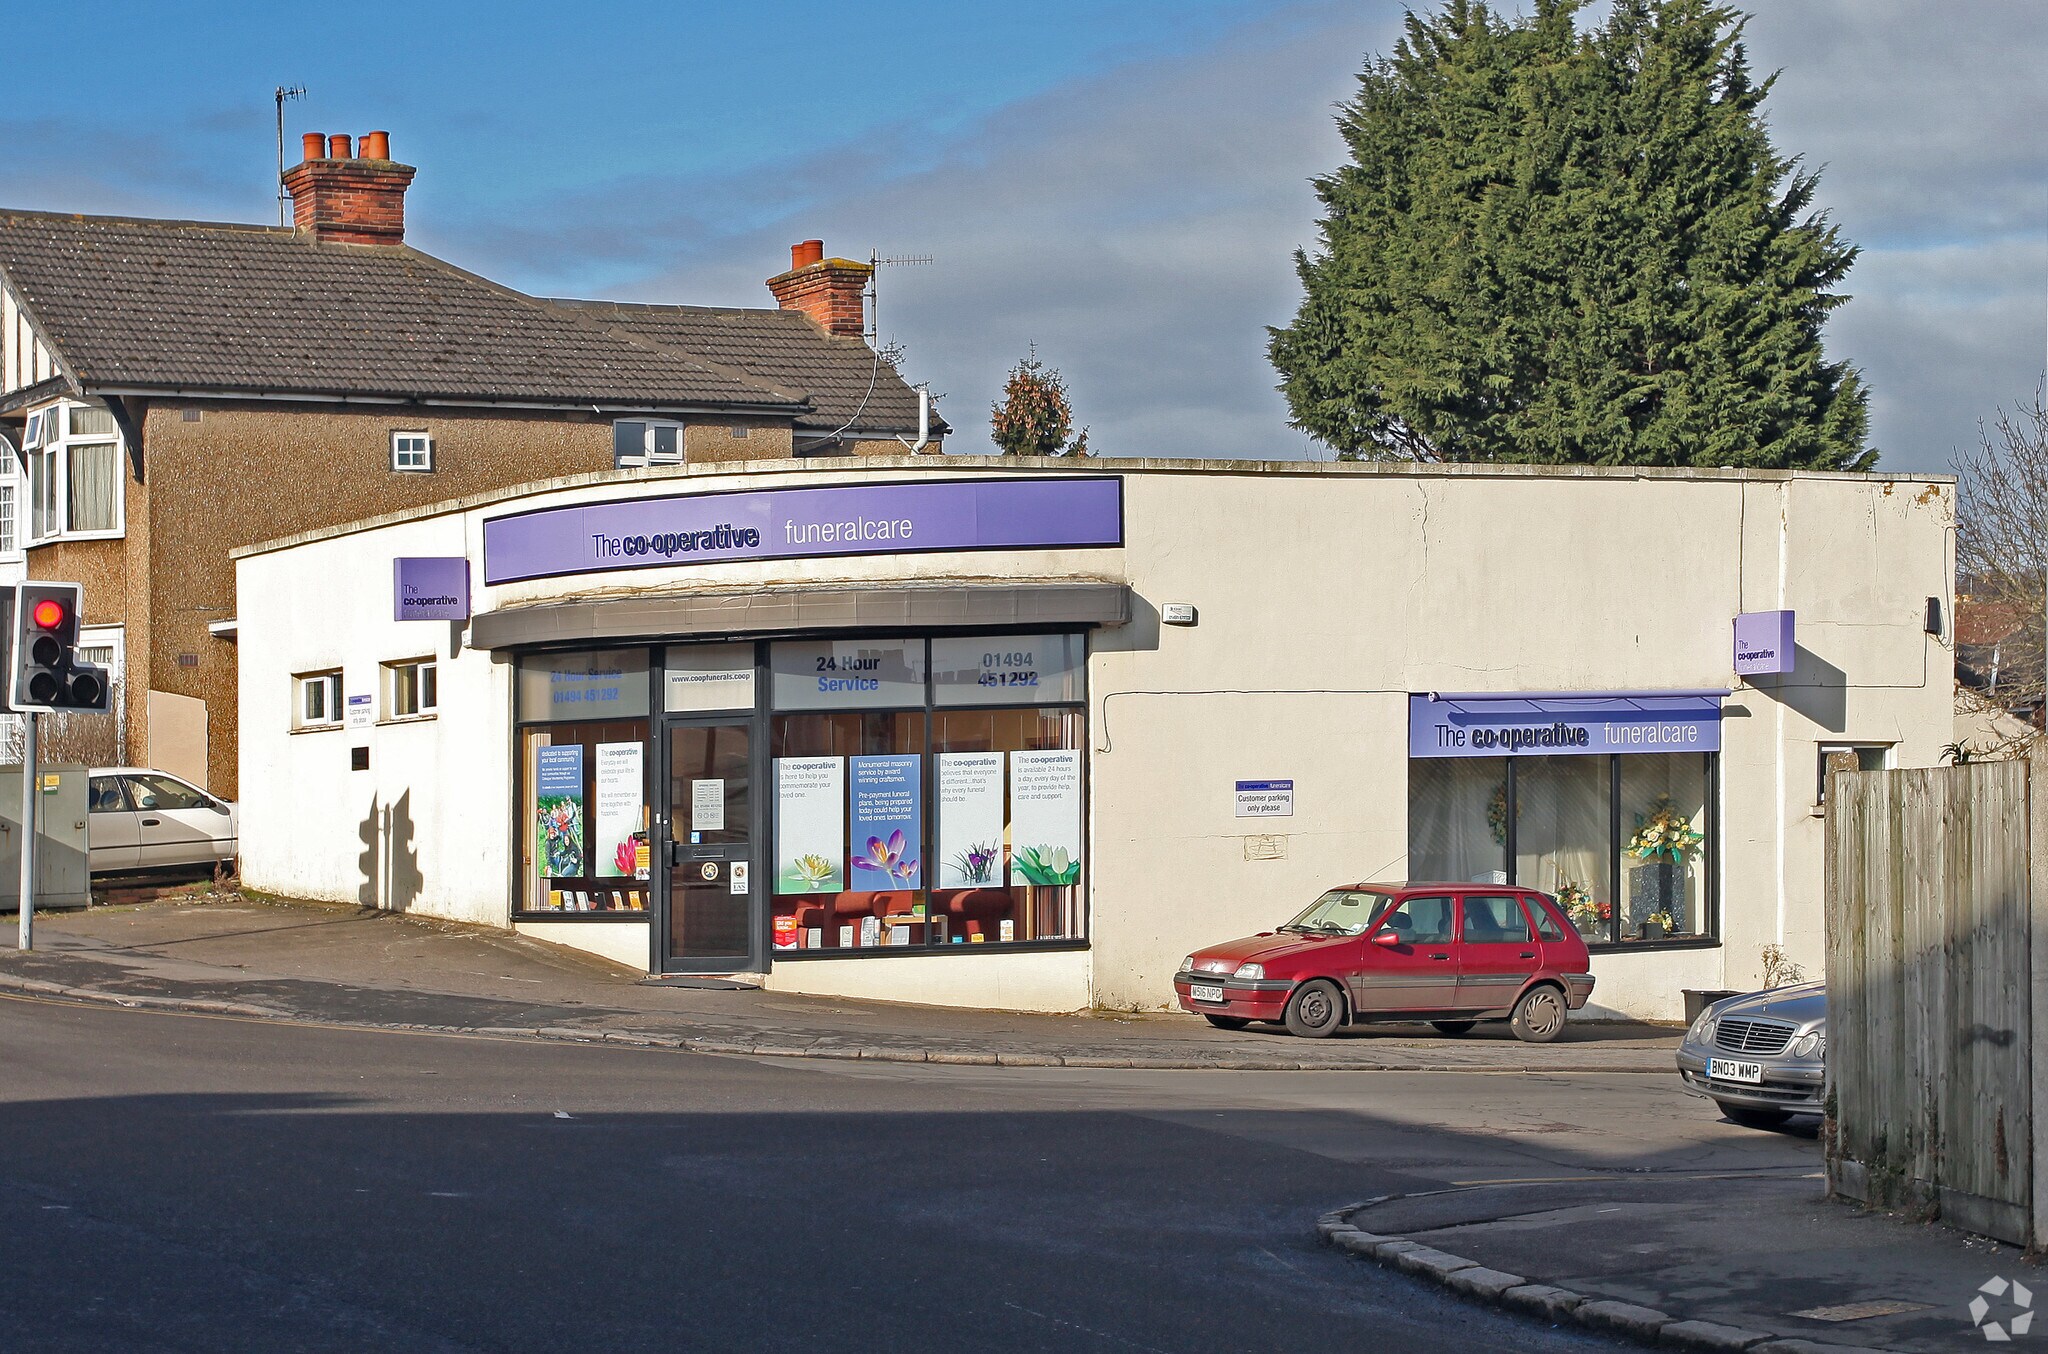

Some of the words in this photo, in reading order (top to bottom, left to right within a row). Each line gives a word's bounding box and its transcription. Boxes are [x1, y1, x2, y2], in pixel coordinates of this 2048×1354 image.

[591, 533, 620, 558] The
[622, 523, 761, 557] co-operative
[784, 516, 913, 544] funeralcare
[404, 585, 418, 594] The
[404, 595, 458, 607] co-operative
[1738, 640, 1748, 649] The
[983, 652, 1033, 667] 01494
[1738, 650, 1774, 661] co-operative
[817, 656, 836, 671] 24
[842, 655, 880, 670] Hour
[551, 670, 562, 683] 24
[565, 669, 584, 682] Hour
[588, 668, 624, 681] Service
[672, 673, 750, 683] www.coopfunerals.coop
[978, 671, 1038, 687] 451292
[818, 676, 879, 691] Service
[554, 690, 582, 703] 01494
[584, 687, 619, 702] 451292
[1434, 724, 1465, 747] The
[1470, 723, 1588, 751] co-operative
[1604, 721, 1698, 744] funeralcare
[953, 758, 997, 767] co-operative
[1030, 755, 1073, 764] co-operative
[792, 762, 836, 771] co-operative
[890, 798, 913, 806] prepared
[1238, 794, 1267, 802] Customer
[1268, 794, 1290, 802] parking
[1247, 804, 1260, 812] only
[1261, 804, 1280, 812] please
[1712, 1060, 1736, 1076] BN03
[1738, 1064, 1759, 1079] WMP
